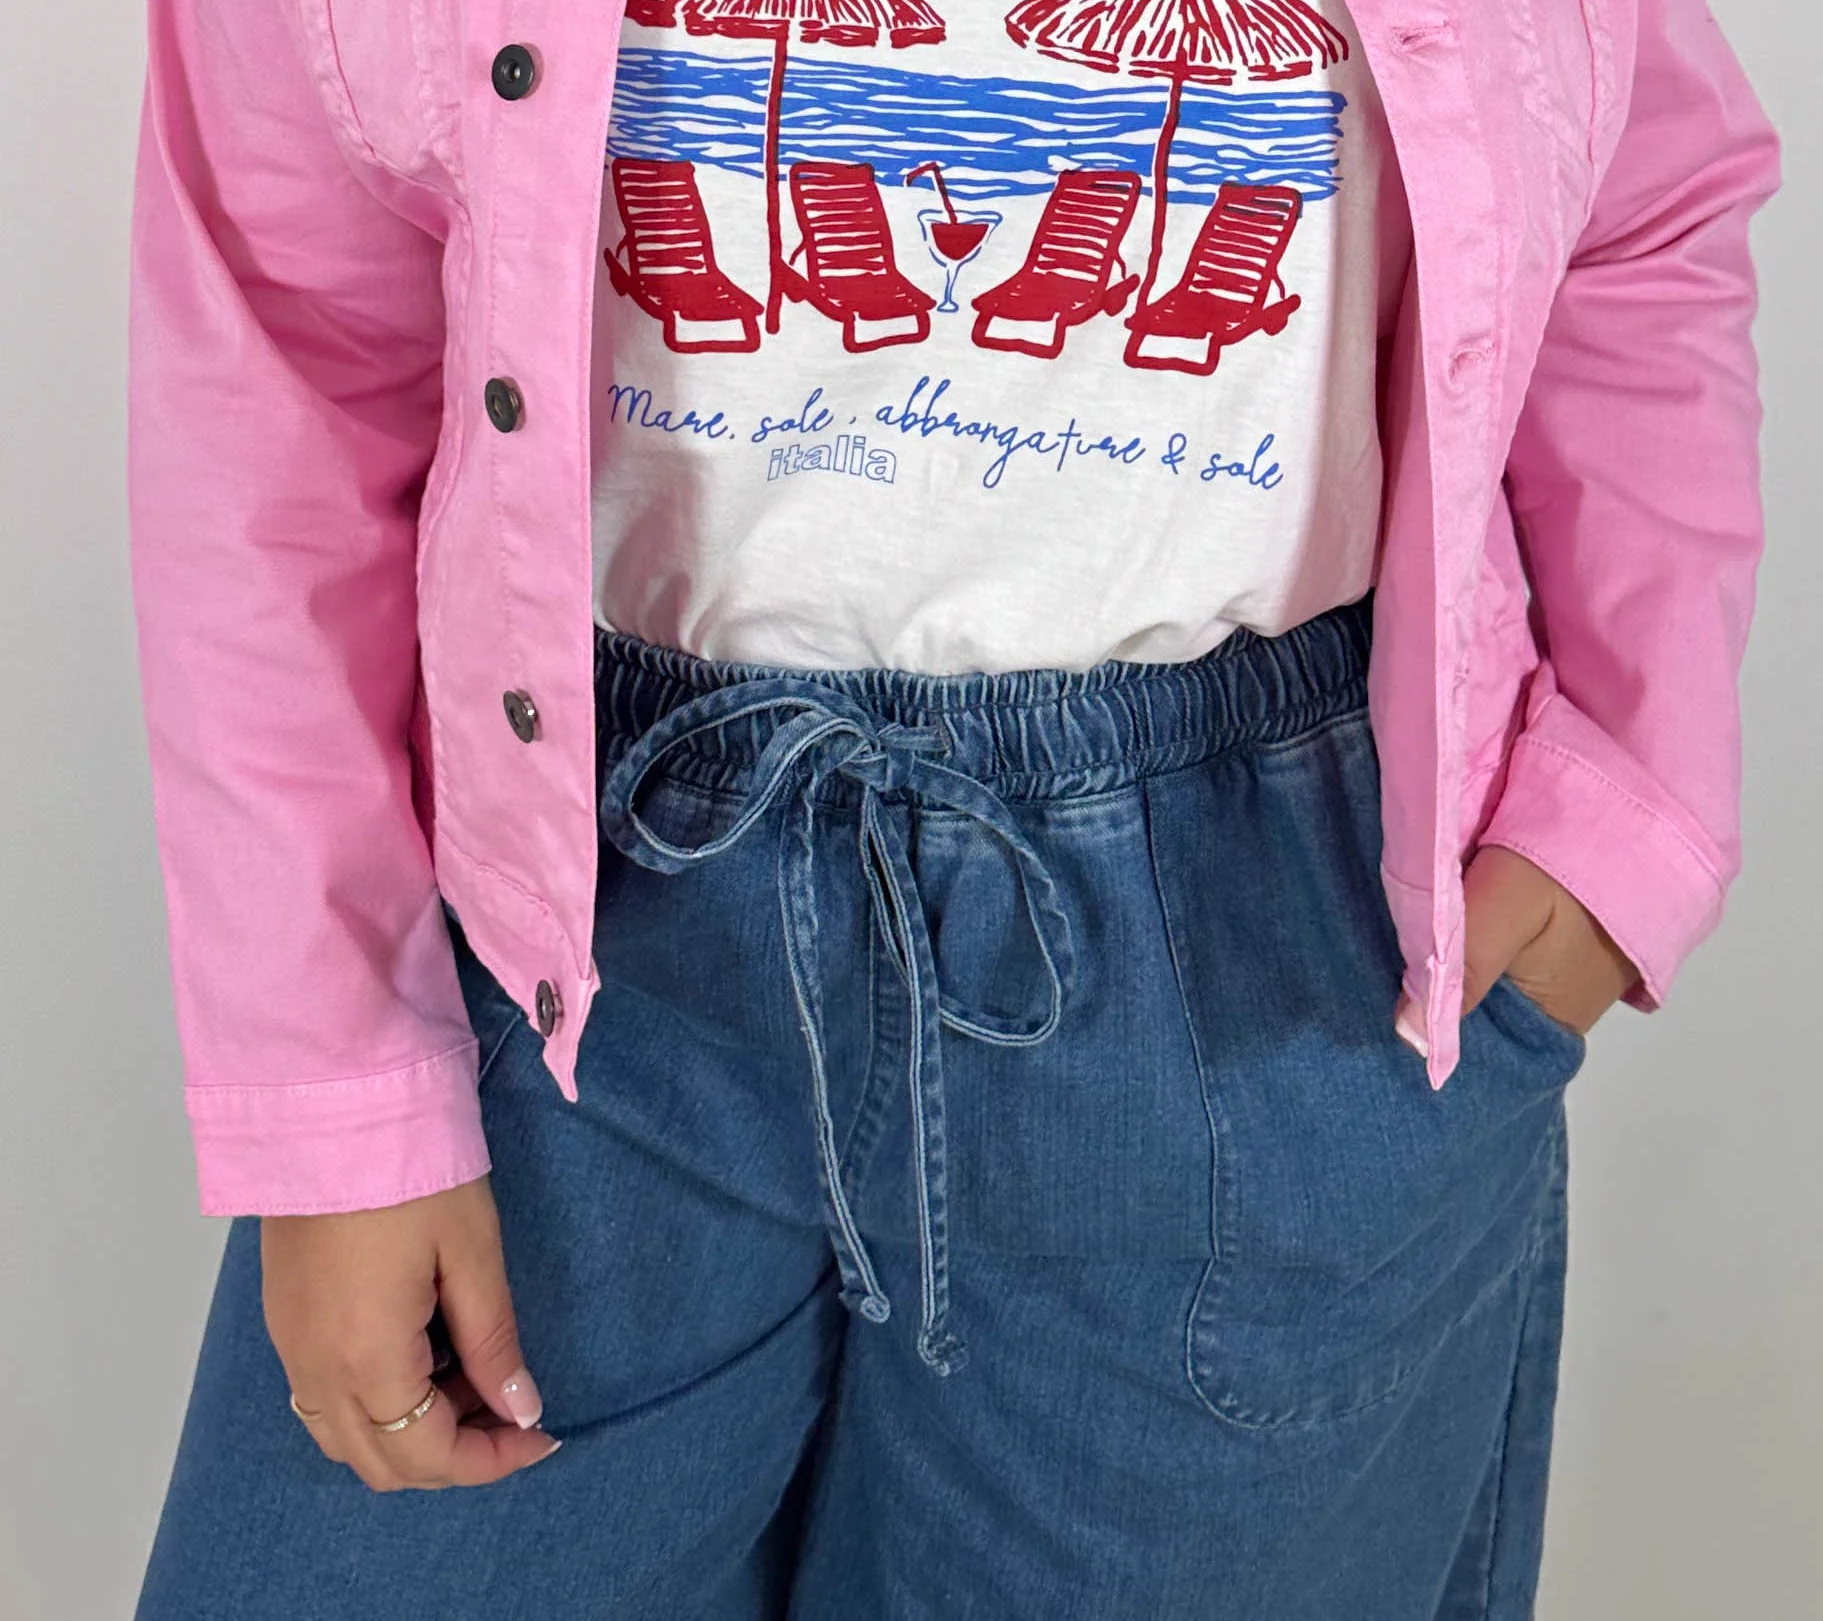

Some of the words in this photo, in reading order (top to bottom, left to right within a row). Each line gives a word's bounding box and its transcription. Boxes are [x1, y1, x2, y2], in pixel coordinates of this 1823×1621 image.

[766, 434, 898, 485] italia
[1160, 432, 1188, 476] &
[1199, 433, 1285, 490] sole
